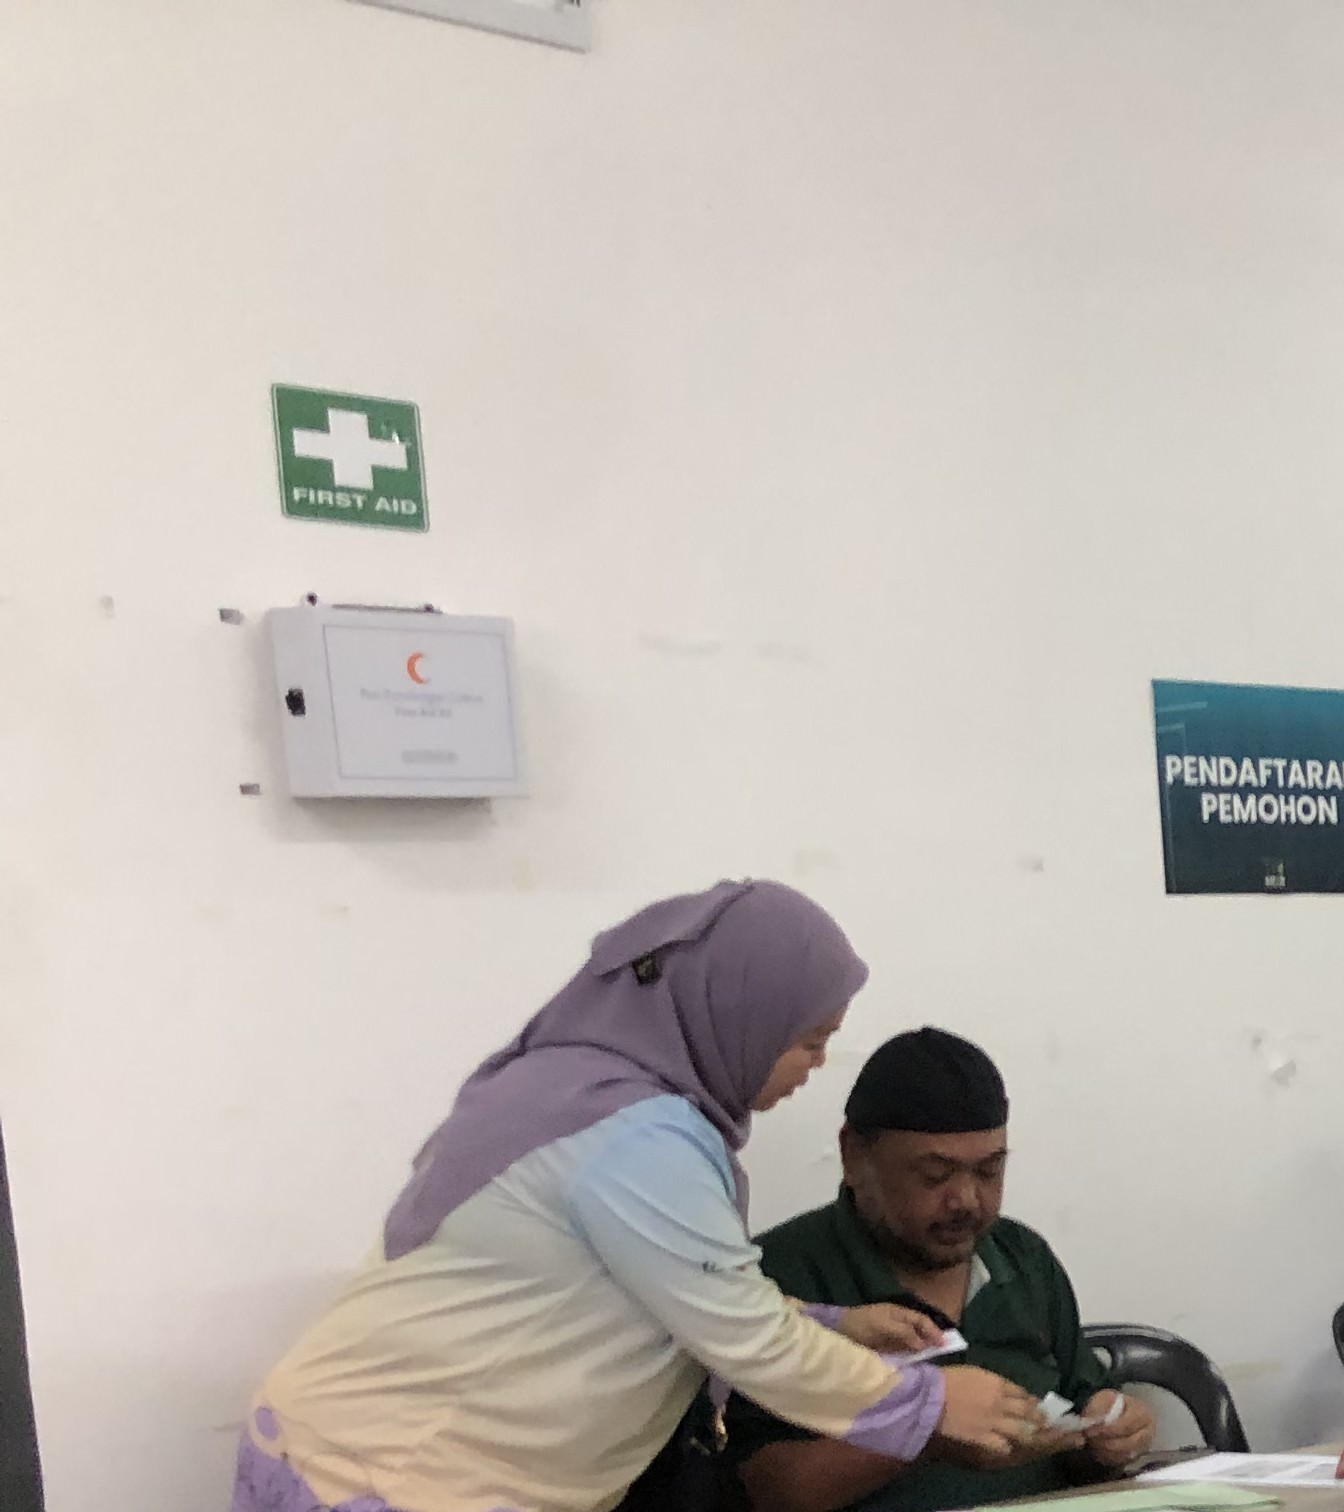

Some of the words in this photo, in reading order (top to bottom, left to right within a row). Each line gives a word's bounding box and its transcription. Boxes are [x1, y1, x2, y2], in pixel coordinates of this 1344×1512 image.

[293, 487, 367, 510] FIRST
[375, 496, 417, 515] AID
[1201, 792, 1339, 825] PEMOHON
